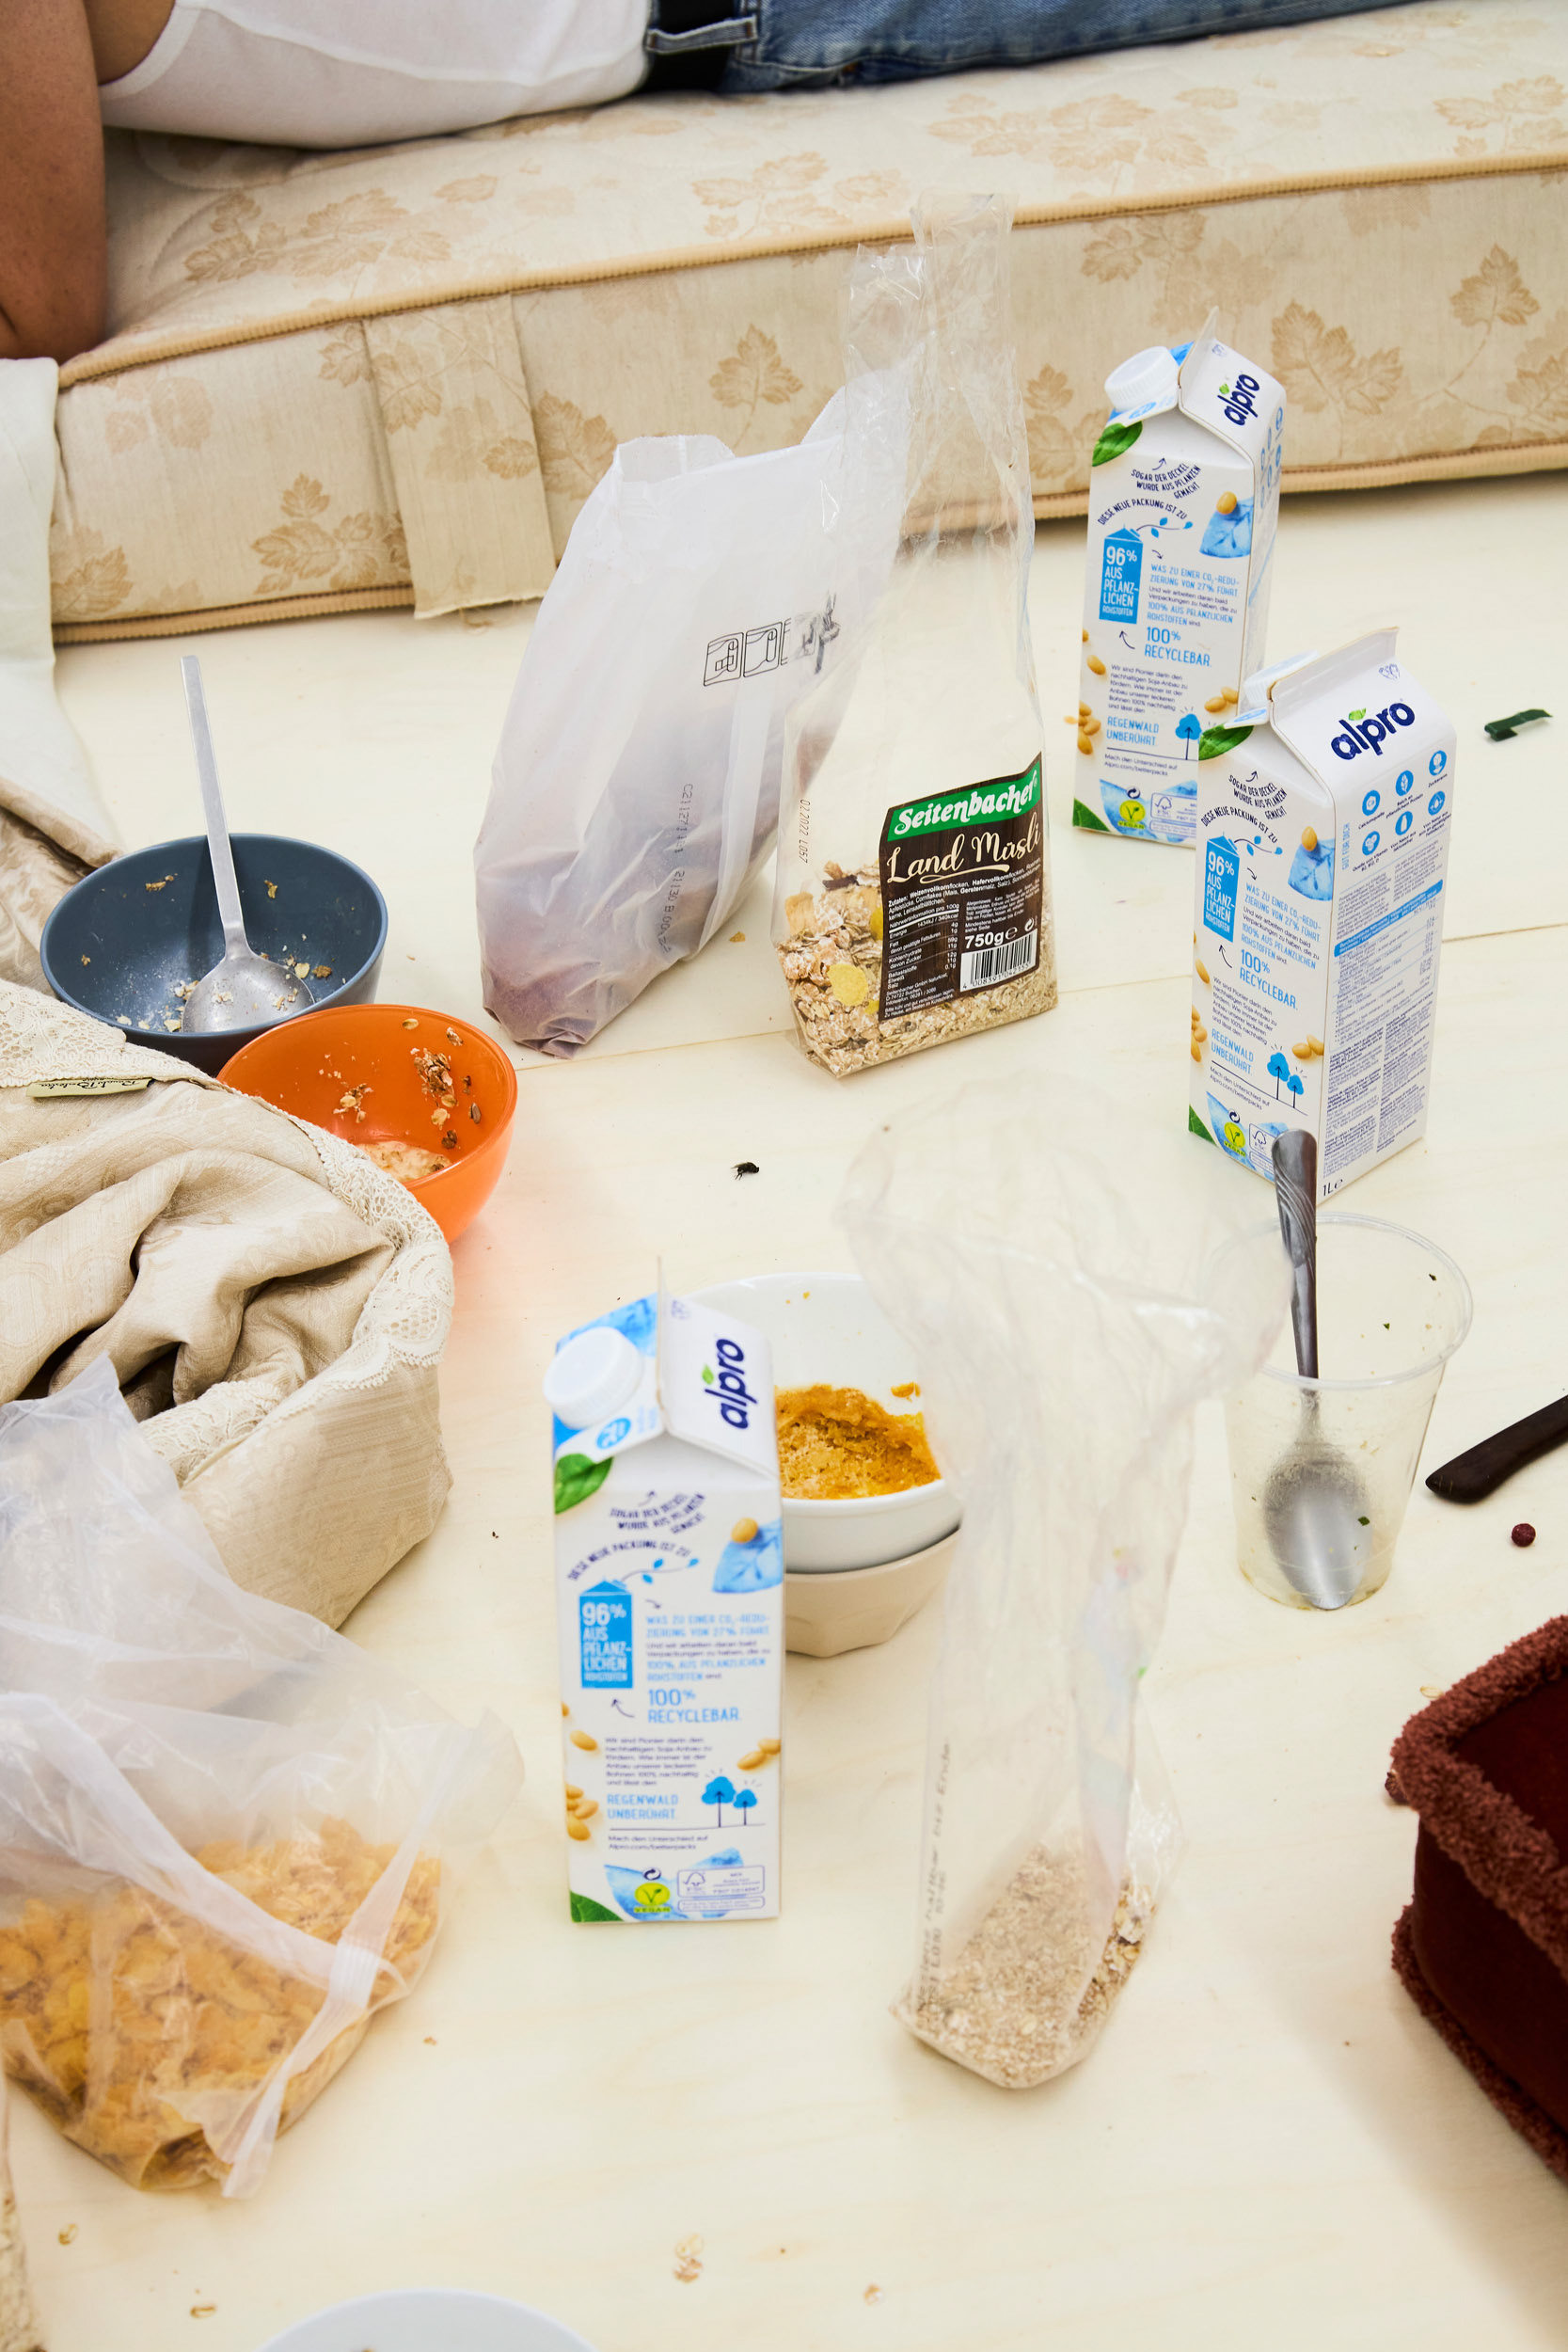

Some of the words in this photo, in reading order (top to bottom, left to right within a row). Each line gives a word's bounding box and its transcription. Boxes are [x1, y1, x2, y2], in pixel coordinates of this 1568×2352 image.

[1217, 373, 1260, 426] alpro
[1131, 469, 1152, 481] SOGAR
[1167, 463, 1189, 479] DECKEL
[1136, 481, 1159, 491] WURDE
[1174, 465, 1200, 486] PFLANZEN
[1174, 482, 1199, 498] GEMACHT
[1097, 508, 1115, 525] DIESE
[1113, 500, 1131, 512] NEUE
[1131, 498, 1164, 509] PACKUNG
[1164, 503, 1176, 513] IST
[1176, 510, 1187, 519] ZU
[1105, 545, 1138, 568] 96%
[1104, 564, 1122, 580] AUS
[1150, 564, 1166, 573] WAS
[1169, 566, 1179, 575] ZU
[1180, 568, 1199, 579] EINER
[1103, 578, 1138, 595] PFLANZ-
[1148, 574, 1179, 586] ZIERUNG
[1180, 579, 1195, 589] VON
[1196, 581, 1214, 593] 27%
[1103, 591, 1133, 608] LICHEN
[1146, 612, 1187, 626] ROHSTOFFEN
[1148, 601, 1167, 612] 100%
[1170, 605, 1183, 614] AUS
[1185, 608, 1234, 623] PFLANZLICHEN
[1146, 626, 1181, 645] 100%
[1107, 715, 1159, 734] REGENWALD
[1330, 702, 1415, 760] alpro
[1228, 774, 1246, 793] SOGAR
[1259, 782, 1276, 796] DECKEL
[1233, 788, 1252, 805] WURDE
[1254, 799, 1264, 807] AUS
[1264, 787, 1287, 806] PFLANZEN
[1264, 805, 1287, 819] GEMACHT
[1200, 810, 1215, 826] DIESE
[1214, 806, 1229, 816] NEUE
[1229, 806, 1258, 826] PACKUNG
[1258, 820, 1268, 834] IST
[1268, 832, 1277, 843] ZU
[798, 839, 808, 865] L057
[887, 834, 965, 883] Land
[971, 812, 1041, 864] Müsli
[1208, 850, 1234, 882] 96%
[1207, 870, 1221, 891] AUS
[889, 896, 908, 907] Zutaten:
[1206, 883, 1234, 912] PFLANZ-
[1245, 882, 1259, 898] WAS
[1261, 890, 1270, 902] ZU
[1271, 896, 1288, 913] EINER
[890, 908, 935, 929] Nährwertinformation
[1206, 898, 1230, 923] LICHEN
[1244, 893, 1269, 914] ZIERUNG
[1271, 908, 1283, 922] VON
[1284, 915, 1299, 931] 27%
[890, 929, 907, 939] Energie
[965, 932, 1004, 949] 750g
[889, 948, 922, 963] Kohlenhydrate
[1241, 932, 1275, 960] ROHSTOFFEN
[1242, 922, 1259, 939] 100%
[1261, 933, 1273, 946] AUS
[1274, 940, 1315, 970] PFLANZLICHEN
[906, 955, 922, 963] Zucker
[1240, 947, 1270, 979] 100%
[888, 976, 905, 984] Eiweiß
[889, 965, 917, 978] Ballaststoffe
[1212, 1027, 1253, 1063] REGENWALD
[705, 1338, 758, 1430] alpro
[582, 1601, 626, 1626] 96%
[583, 1626, 607, 1641] AUS
[584, 1640, 631, 1656] PFLANZ-
[585, 1655, 626, 1671] LICHEN
[648, 1687, 696, 1706] 100%
[608, 1792, 677, 1805] REGENWALD
